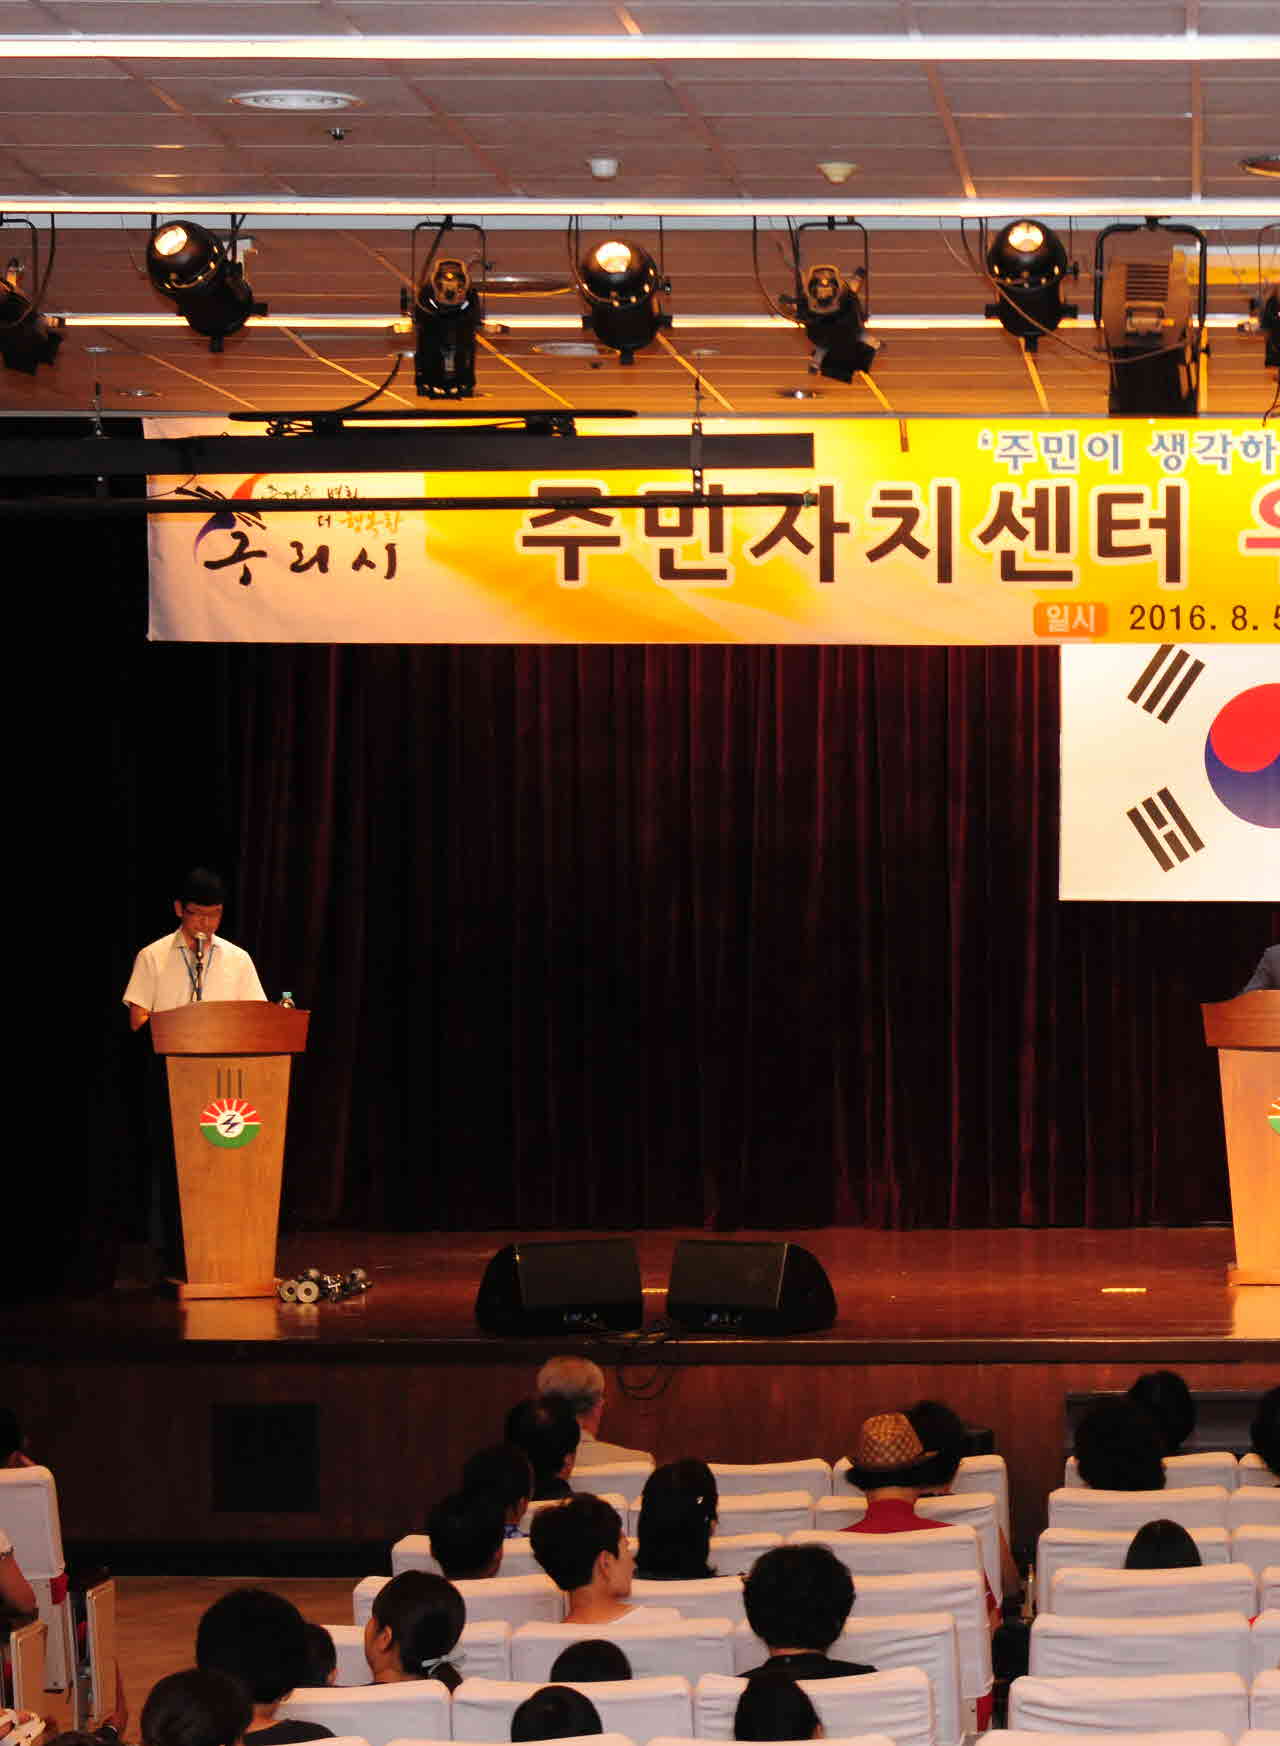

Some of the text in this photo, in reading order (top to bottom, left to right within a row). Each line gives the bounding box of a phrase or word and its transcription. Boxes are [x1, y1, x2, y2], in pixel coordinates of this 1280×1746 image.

[521, 483, 1182, 584] 주민자치센터
[1045, 603, 1096, 633] 일시
[1129, 604, 1218, 632] 2016.
[1230, 604, 1259, 632] 8.
